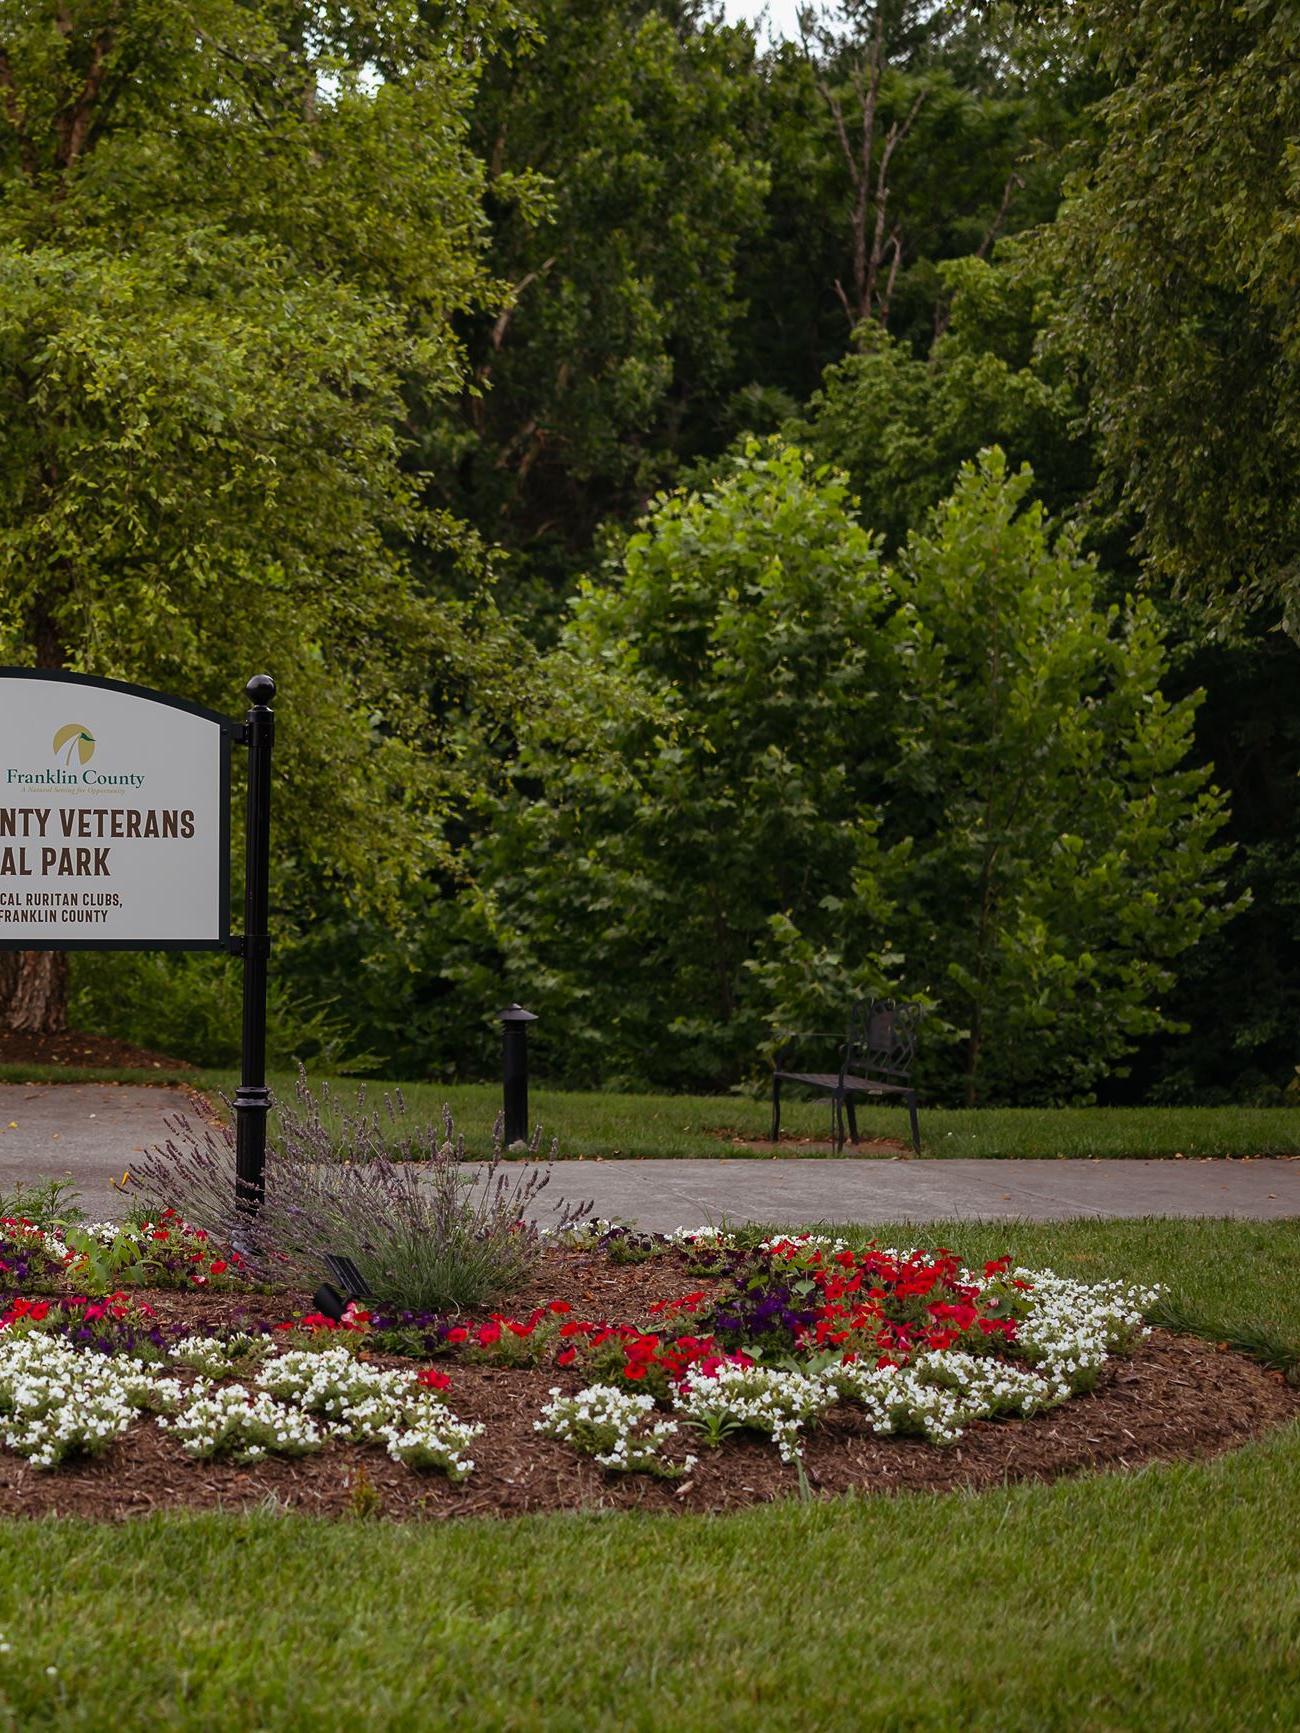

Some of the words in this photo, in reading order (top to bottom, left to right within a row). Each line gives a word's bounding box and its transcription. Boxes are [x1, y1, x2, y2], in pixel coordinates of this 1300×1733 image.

[7, 769, 77, 784] Franklin
[83, 770, 144, 788] County
[59, 809, 194, 838] VETERANS
[42, 847, 111, 876] PARK
[26, 893, 78, 906] RURITAN
[83, 893, 122, 908] CLUBS,
[62, 910, 108, 922] COUNTY
